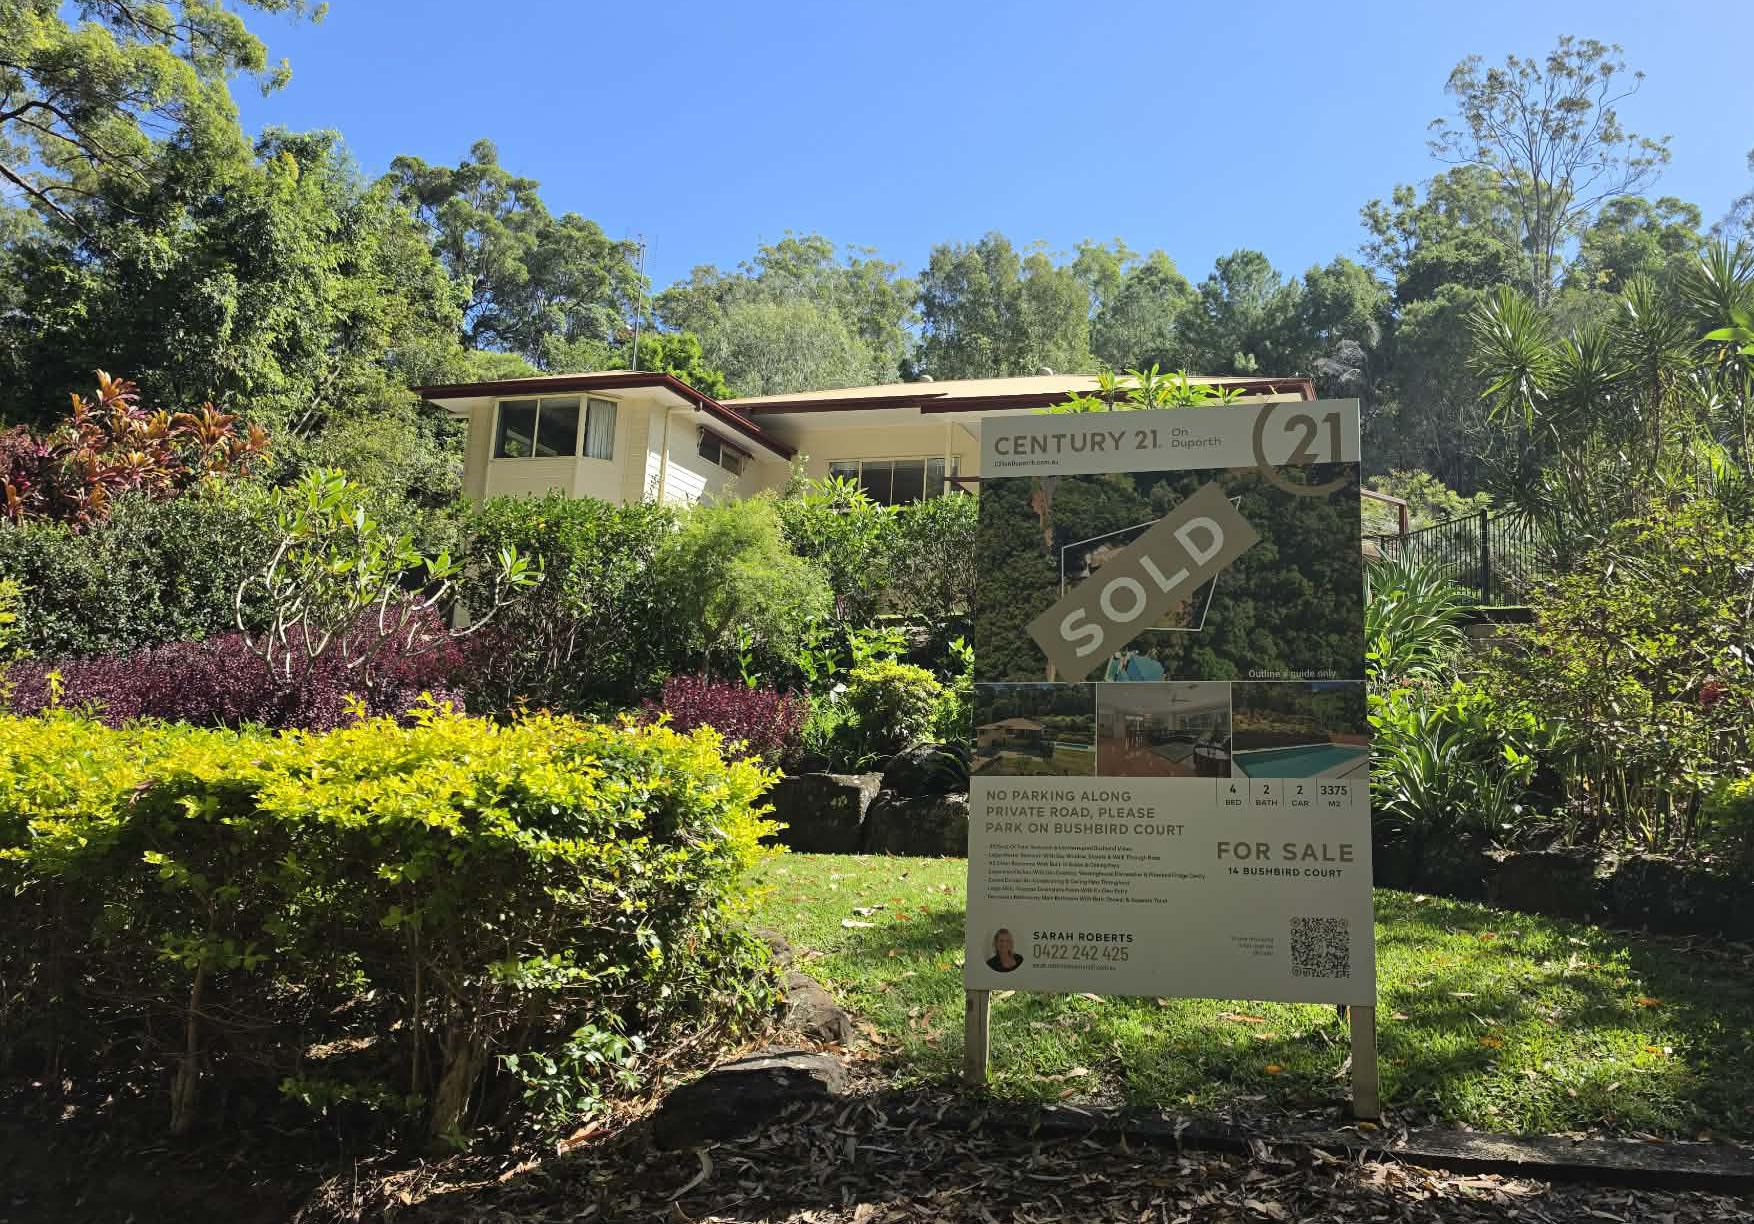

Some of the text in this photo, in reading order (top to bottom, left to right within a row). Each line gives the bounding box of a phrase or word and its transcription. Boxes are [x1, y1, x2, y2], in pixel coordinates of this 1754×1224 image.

[1170, 426, 1190, 437] On
[1282, 411, 1343, 464] 21
[994, 429, 1127, 456] CENTURY
[1170, 436, 1222, 449] Duporth
[1059, 515, 1226, 659] SOLD
[1248, 668, 1281, 679] Outline
[1290, 668, 1315, 682] guide
[1317, 668, 1337, 681] only
[1229, 784, 1237, 795] 4
[1263, 785, 1270, 796] 2
[1297, 785, 1304, 796] 2
[1320, 785, 1348, 797] 3375
[986, 790, 1132, 803] NO PARKING ALONG
[1225, 799, 1242, 807] BED
[1255, 799, 1278, 807] BATH
[1291, 800, 1309, 808] CAR
[1328, 800, 1341, 808] M2
[986, 806, 1155, 820] PRIVATE ROAD, PLEASE
[985, 822, 1185, 837] PARK ON BUSHBIRD COURT
[1216, 841, 1354, 863] FOR SALE
[1228, 867, 1344, 878] 14 BUSHBIRD COURT
[1032, 930, 1134, 945] SARAH ROBERTS
[1032, 943, 1130, 963] 0422 242 425
